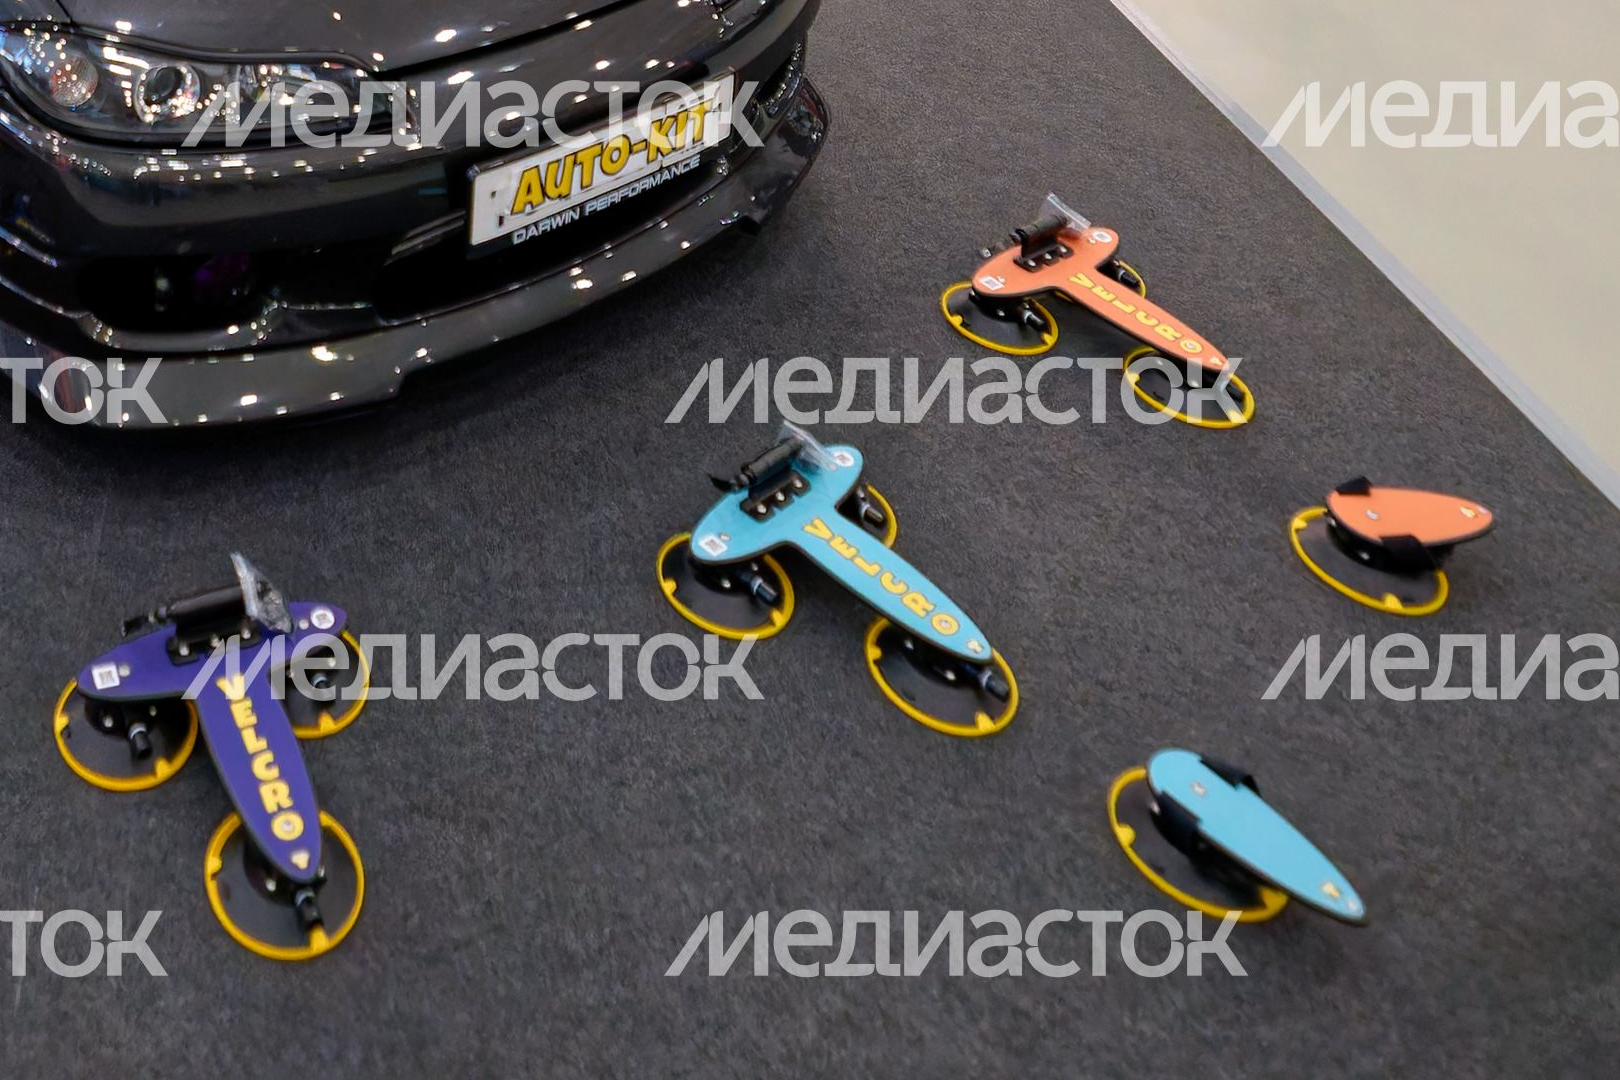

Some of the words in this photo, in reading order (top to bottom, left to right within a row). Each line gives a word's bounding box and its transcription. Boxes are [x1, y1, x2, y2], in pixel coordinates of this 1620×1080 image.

[511, 101, 713, 216] AUTO-KIT
[512, 207, 581, 245] DARWIN
[585, 154, 701, 217] PERFORMANCE
[1068, 272, 1204, 354] VELCRO
[802, 516, 960, 636] VELCRO
[216, 672, 305, 842] VELCRO
